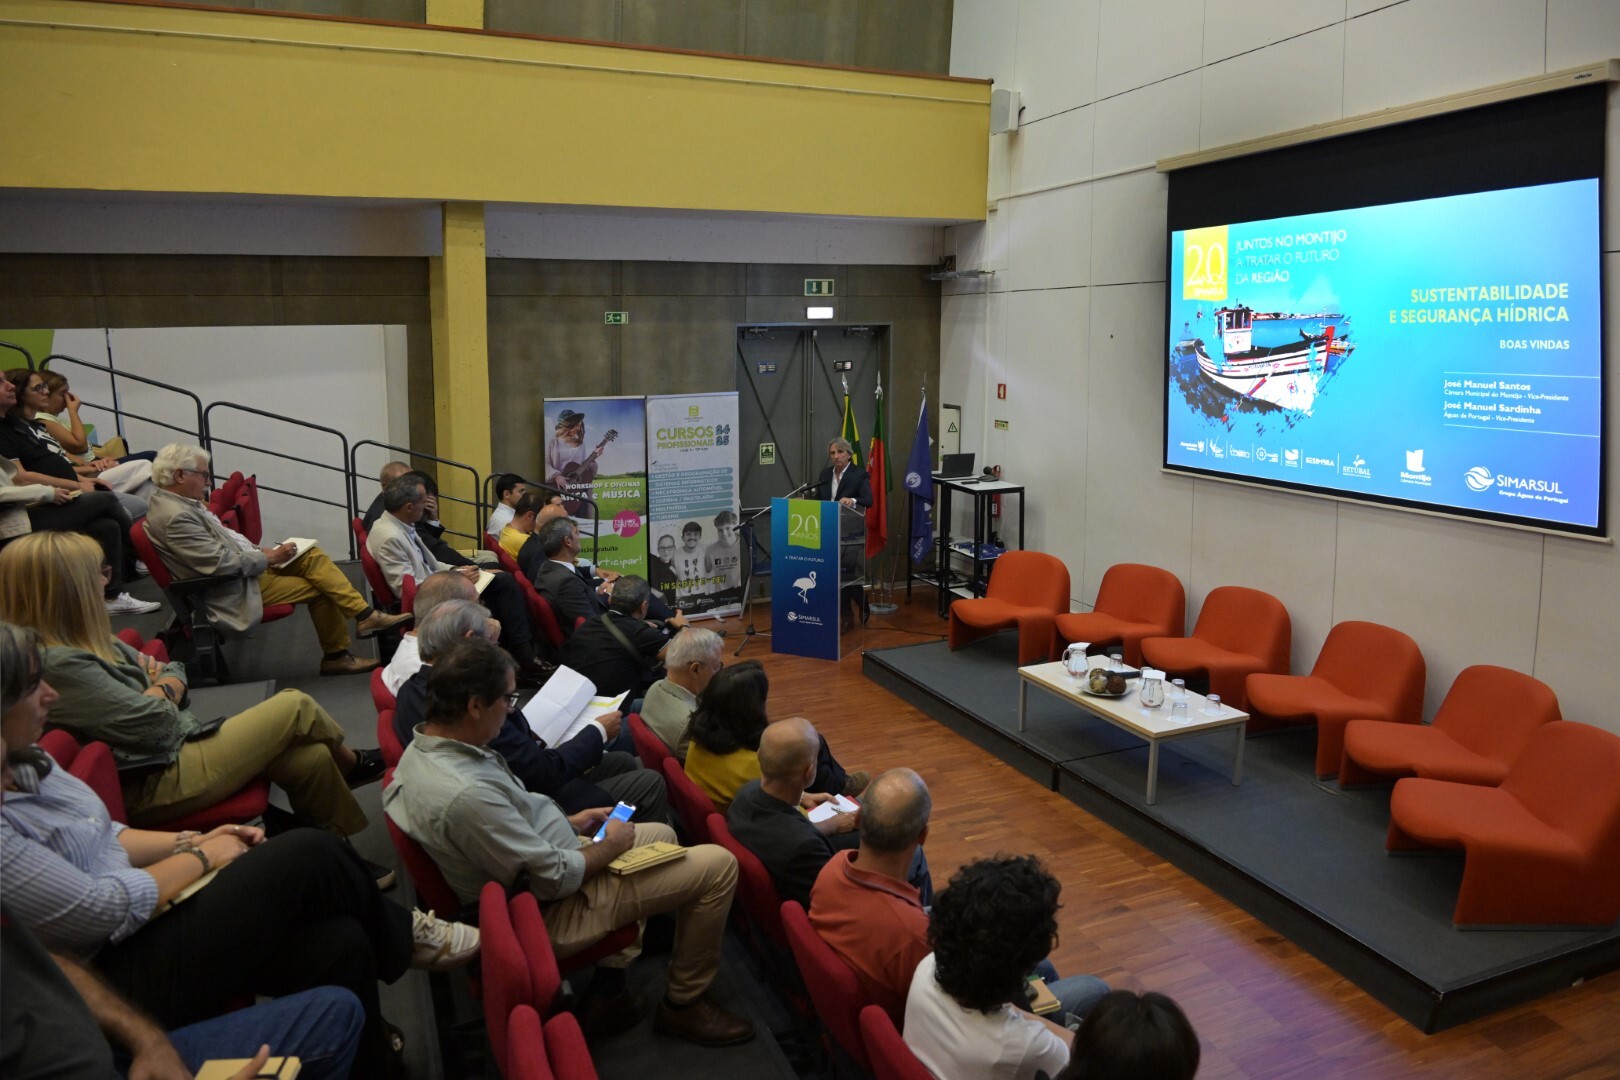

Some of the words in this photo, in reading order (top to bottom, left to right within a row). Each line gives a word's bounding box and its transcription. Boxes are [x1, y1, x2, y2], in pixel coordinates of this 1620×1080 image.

[1236, 237, 1273, 254] JUNTOS
[1276, 235, 1293, 247] NO
[1296, 229, 1347, 245] MONTIJO
[1186, 242, 1225, 287] 20
[1236, 258, 1243, 267] A
[1245, 253, 1281, 267] TRATAR
[1283, 252, 1293, 264] O
[1295, 248, 1340, 263] FUTURO
[1235, 273, 1249, 285] DA
[1251, 269, 1290, 283] REGIÃO
[1411, 283, 1569, 303] SUSTENTABILIDADE
[1389, 310, 1397, 324] E
[1401, 307, 1493, 326] SEGURANÇA
[1497, 303, 1569, 322] HÍDRICA
[1500, 339, 1528, 350] BOAS
[1529, 340, 1570, 350] VINDAS
[1444, 379, 1461, 389] José
[1464, 380, 1496, 390] Manuel
[1499, 381, 1531, 391] Santos
[1465, 390, 1490, 398] Municipal
[1444, 401, 1461, 410] José
[1464, 402, 1496, 411] Manuel
[1499, 404, 1542, 415] Sardinha
[1468, 413, 1491, 421] Portugal
[656, 425, 714, 441] CURSOS
[657, 439, 714, 449] PROFISSIONAIS
[1400, 471, 1432, 481] Montijo
[1497, 474, 1563, 494] SIMARSUL
[602, 487, 641, 499] MÚSICA
[790, 513, 819, 536] 20
